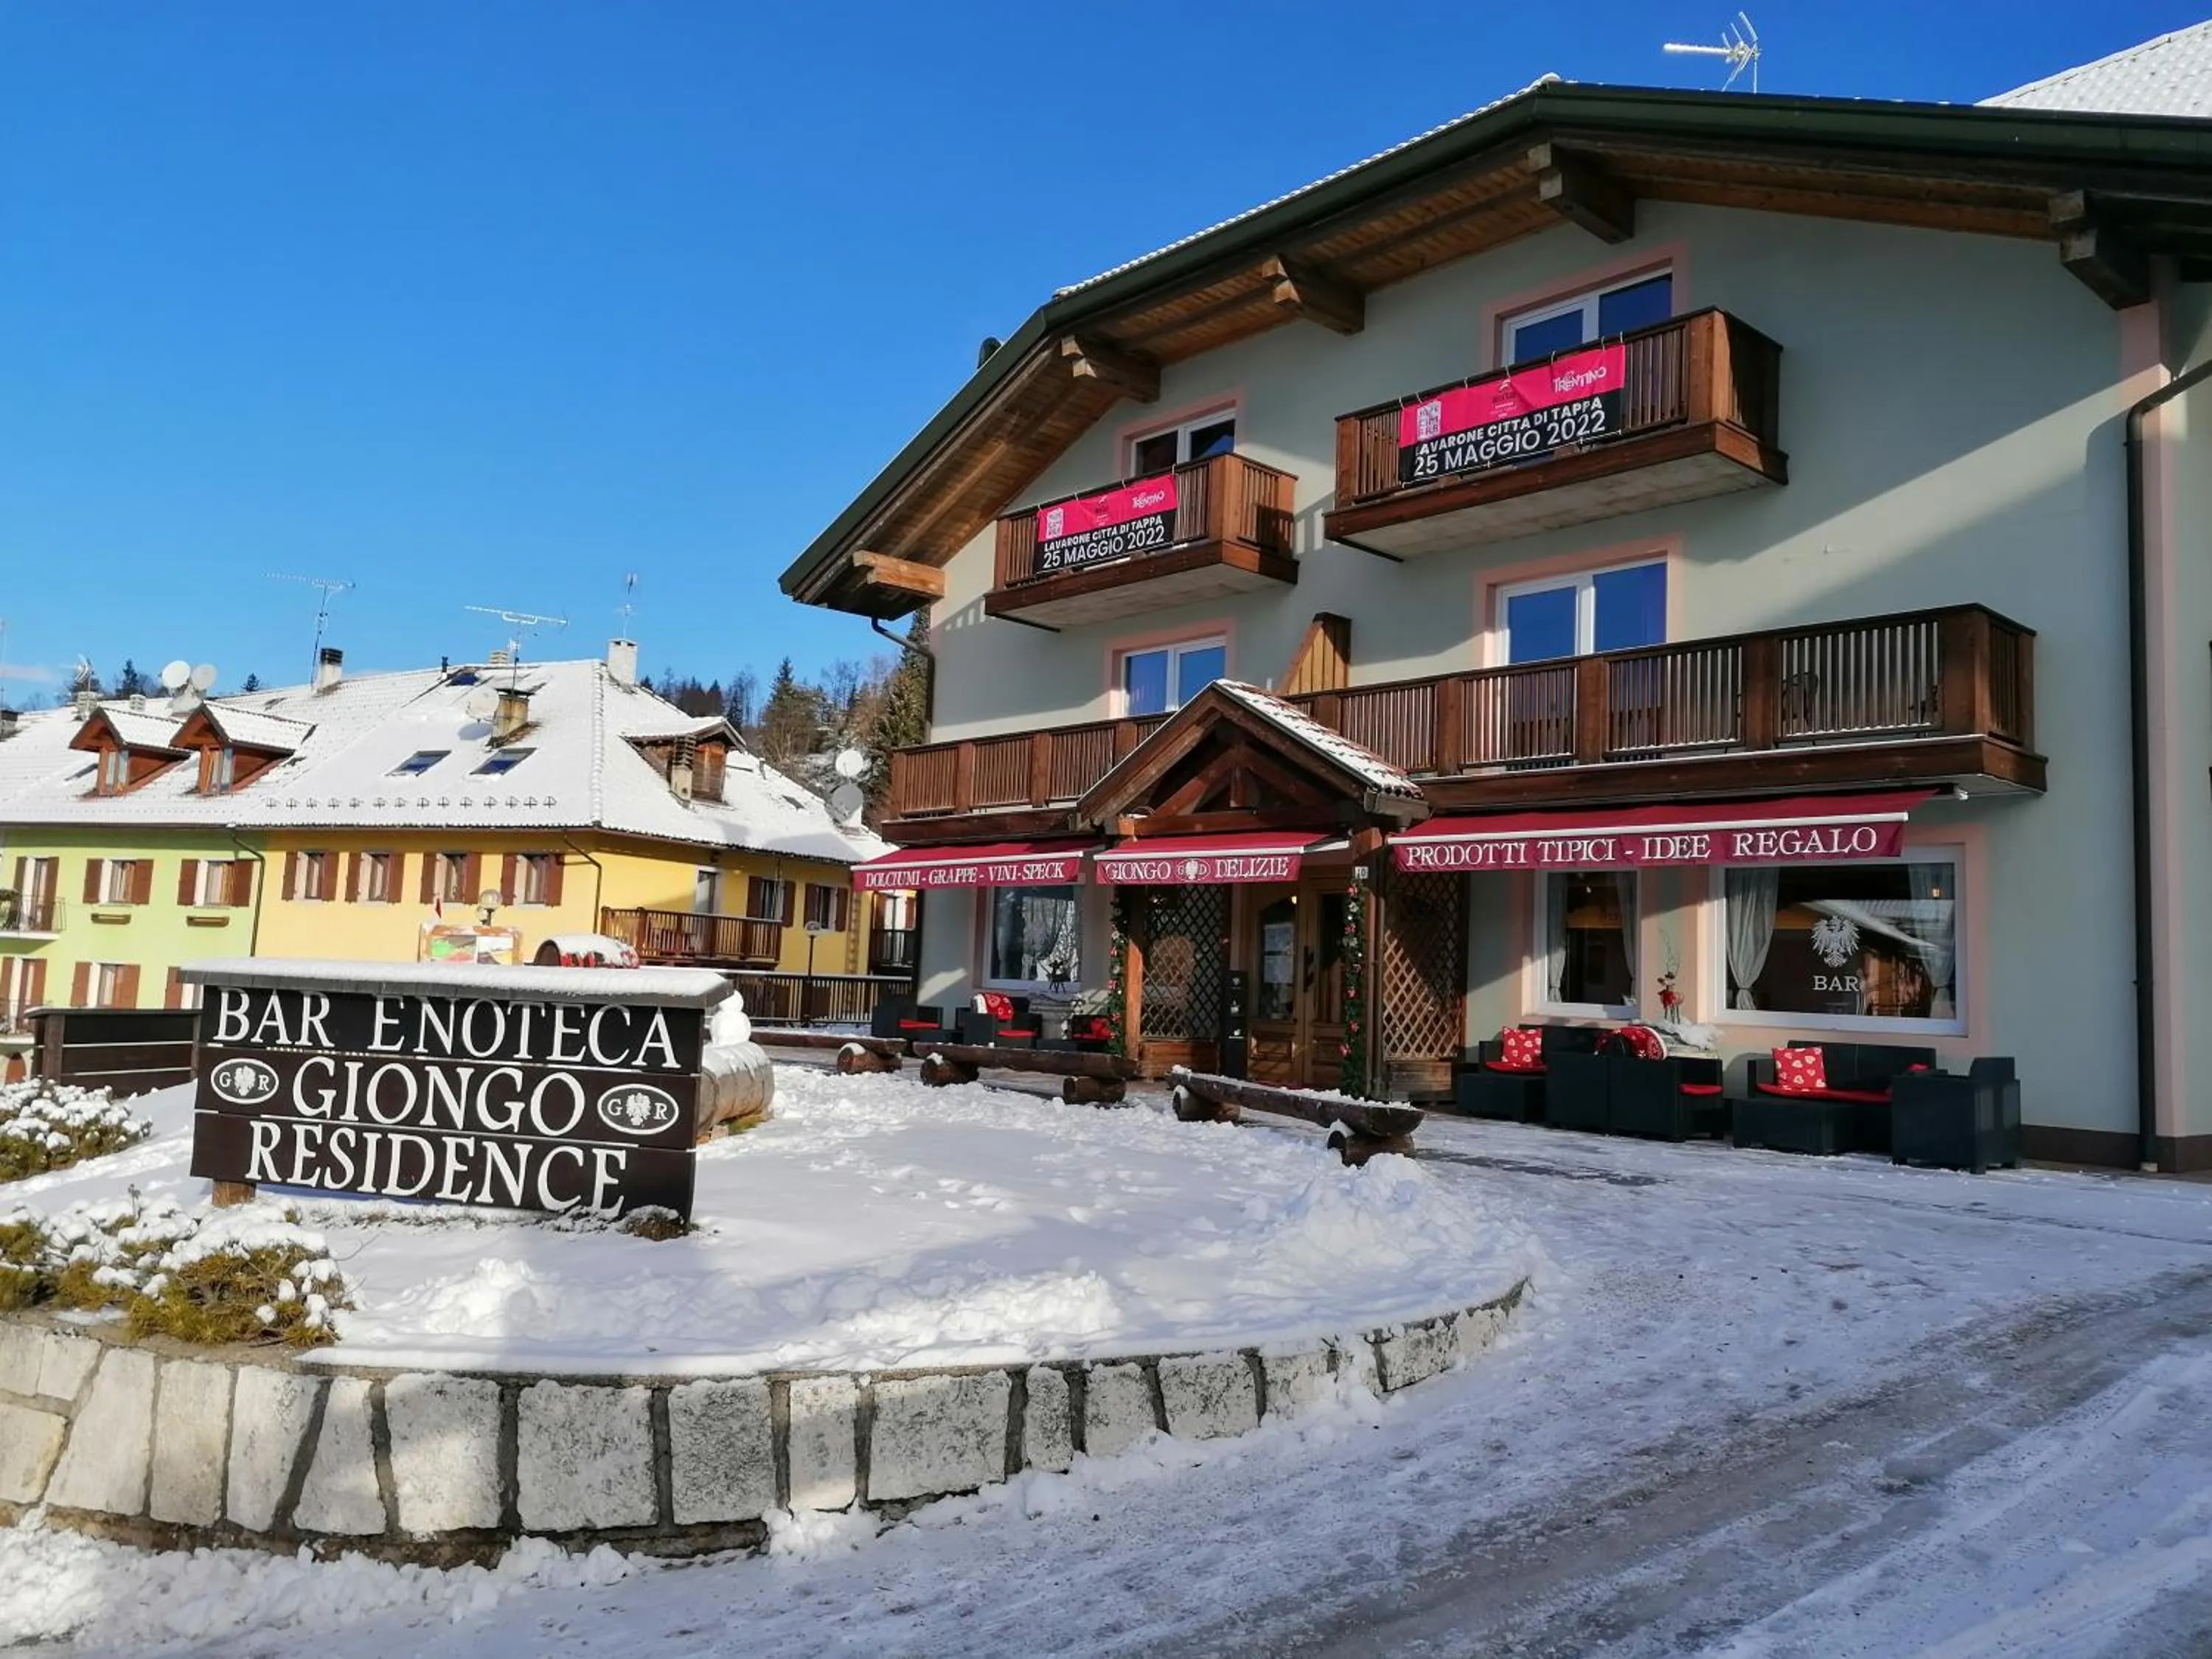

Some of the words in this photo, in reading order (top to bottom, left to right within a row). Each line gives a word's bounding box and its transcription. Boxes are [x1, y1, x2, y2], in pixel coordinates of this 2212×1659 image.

[1534, 412, 1548, 426] DI
[1551, 396, 1602, 422] TAPPA
[1414, 453, 1439, 476] 25
[1444, 430, 1540, 470] MAGGIO
[1547, 409, 1606, 445] 2022
[1043, 551, 1061, 568] 25
[1064, 536, 1124, 564] MAGGIO
[1127, 524, 1165, 550] 2022
[1044, 533, 1091, 552] LAVARONE
[1119, 524, 1130, 535] DI
[1131, 515, 1163, 531] TAPPA
[1406, 842, 1528, 867] PRODOTTI
[1537, 838, 1615, 863] TIPICI
[1641, 833, 1711, 860] IDEE
[1732, 826, 1877, 857] REGALO
[866, 871, 921, 887] DOLCIUMI
[928, 866, 978, 885] GRAPPE
[1106, 861, 1172, 880] GIONGO
[1215, 857, 1289, 878] DELIZIE
[1813, 975, 1859, 992] BAR
[213, 987, 335, 1048] BAR
[367, 994, 681, 1069] ENOTECA
[219, 1071, 232, 1088] G
[257, 1074, 270, 1091] R
[292, 1056, 586, 1136] GIONGO
[607, 1098, 623, 1116] G
[653, 1102, 667, 1120] R
[245, 1120, 627, 1217] RESIDENCE
